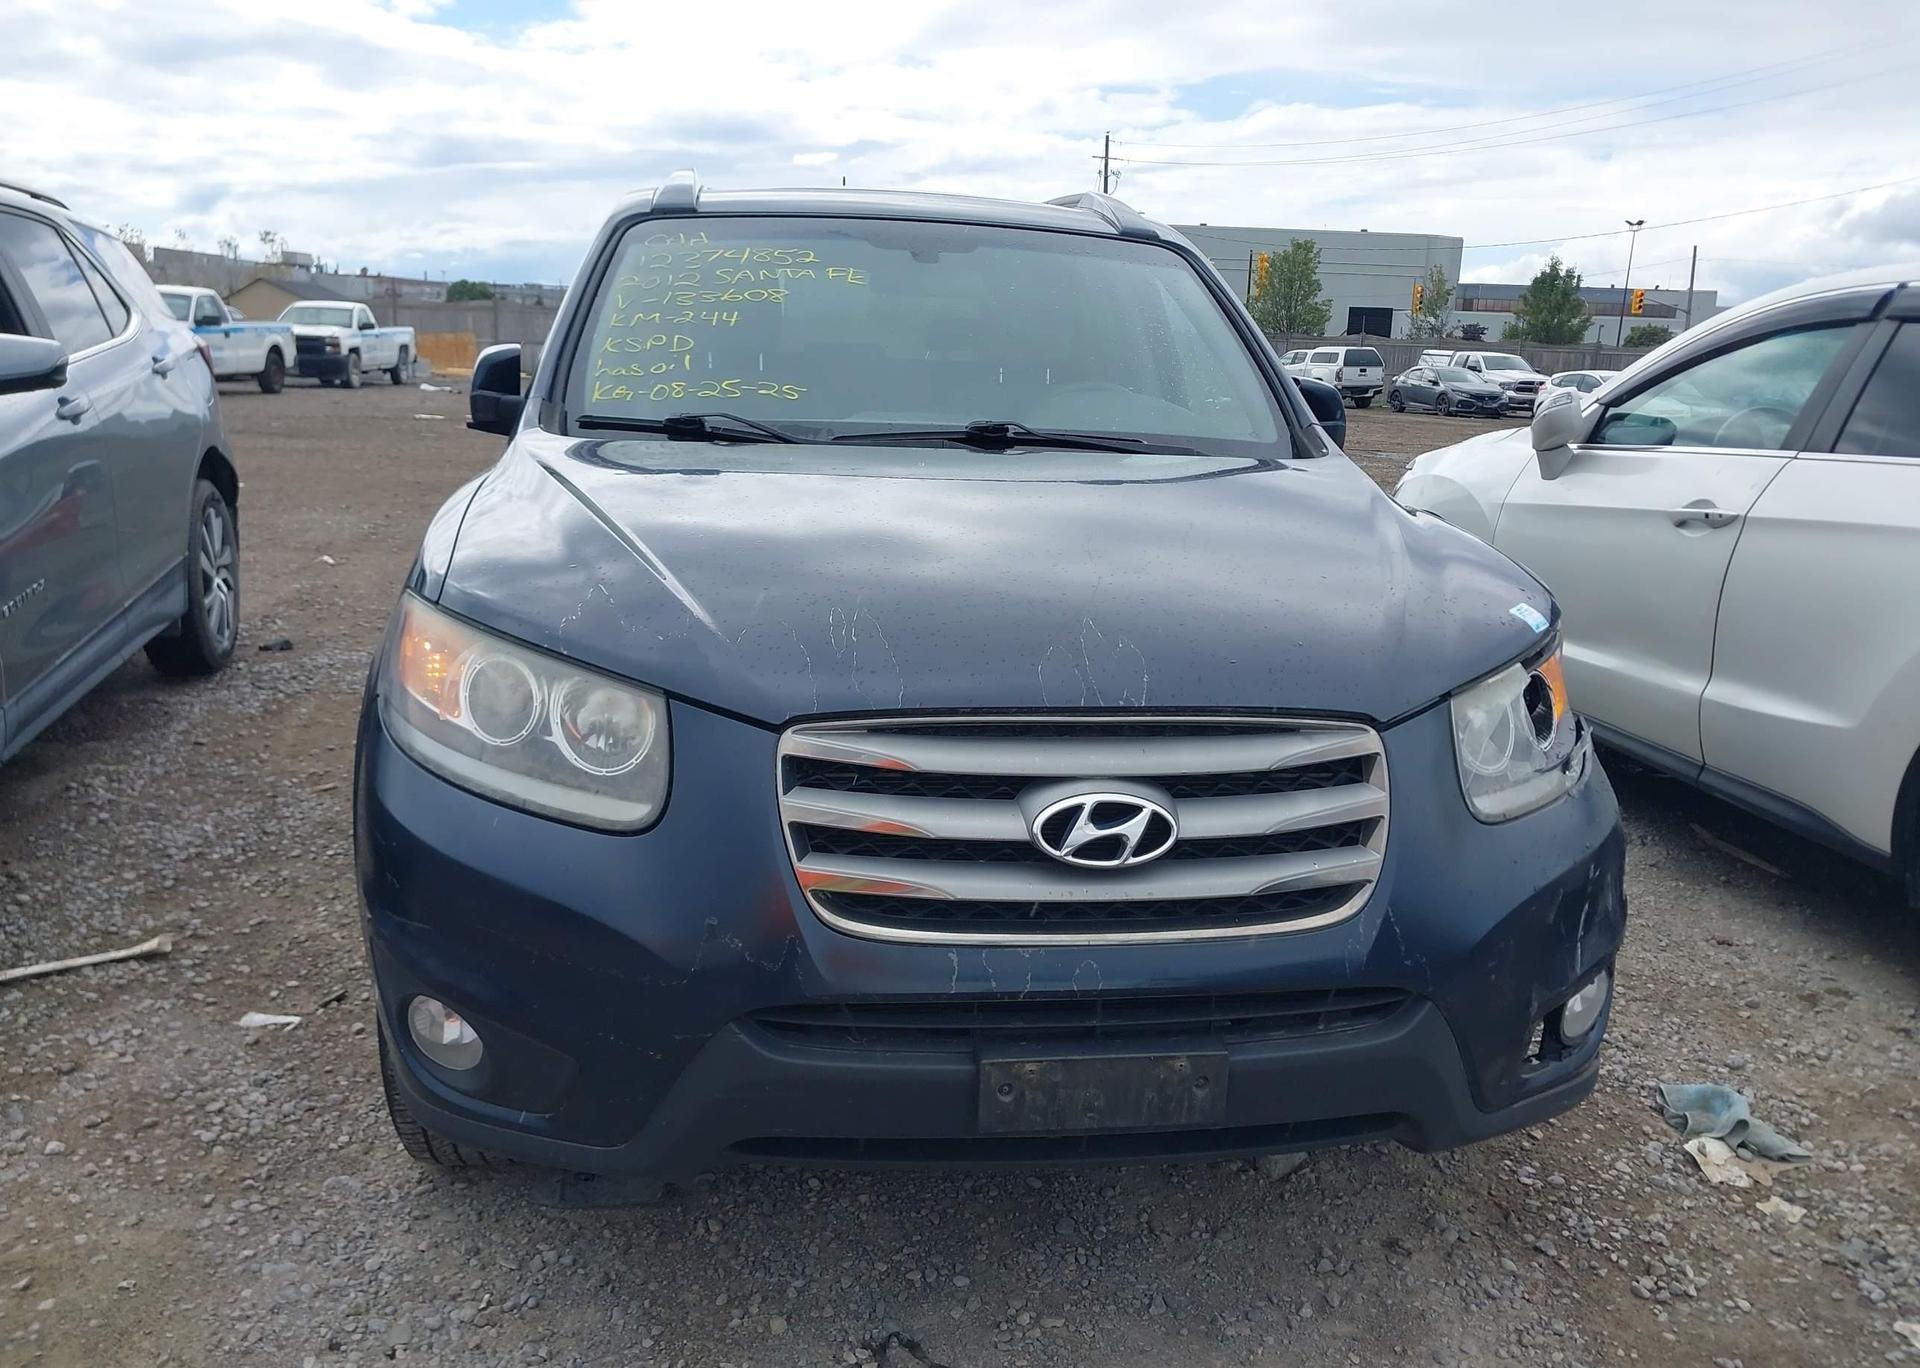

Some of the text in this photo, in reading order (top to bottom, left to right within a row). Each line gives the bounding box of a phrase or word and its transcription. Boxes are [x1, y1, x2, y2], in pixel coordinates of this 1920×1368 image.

[620, 267, 868, 289] 2012 SANTA FE
[595, 359, 644, 377] has
